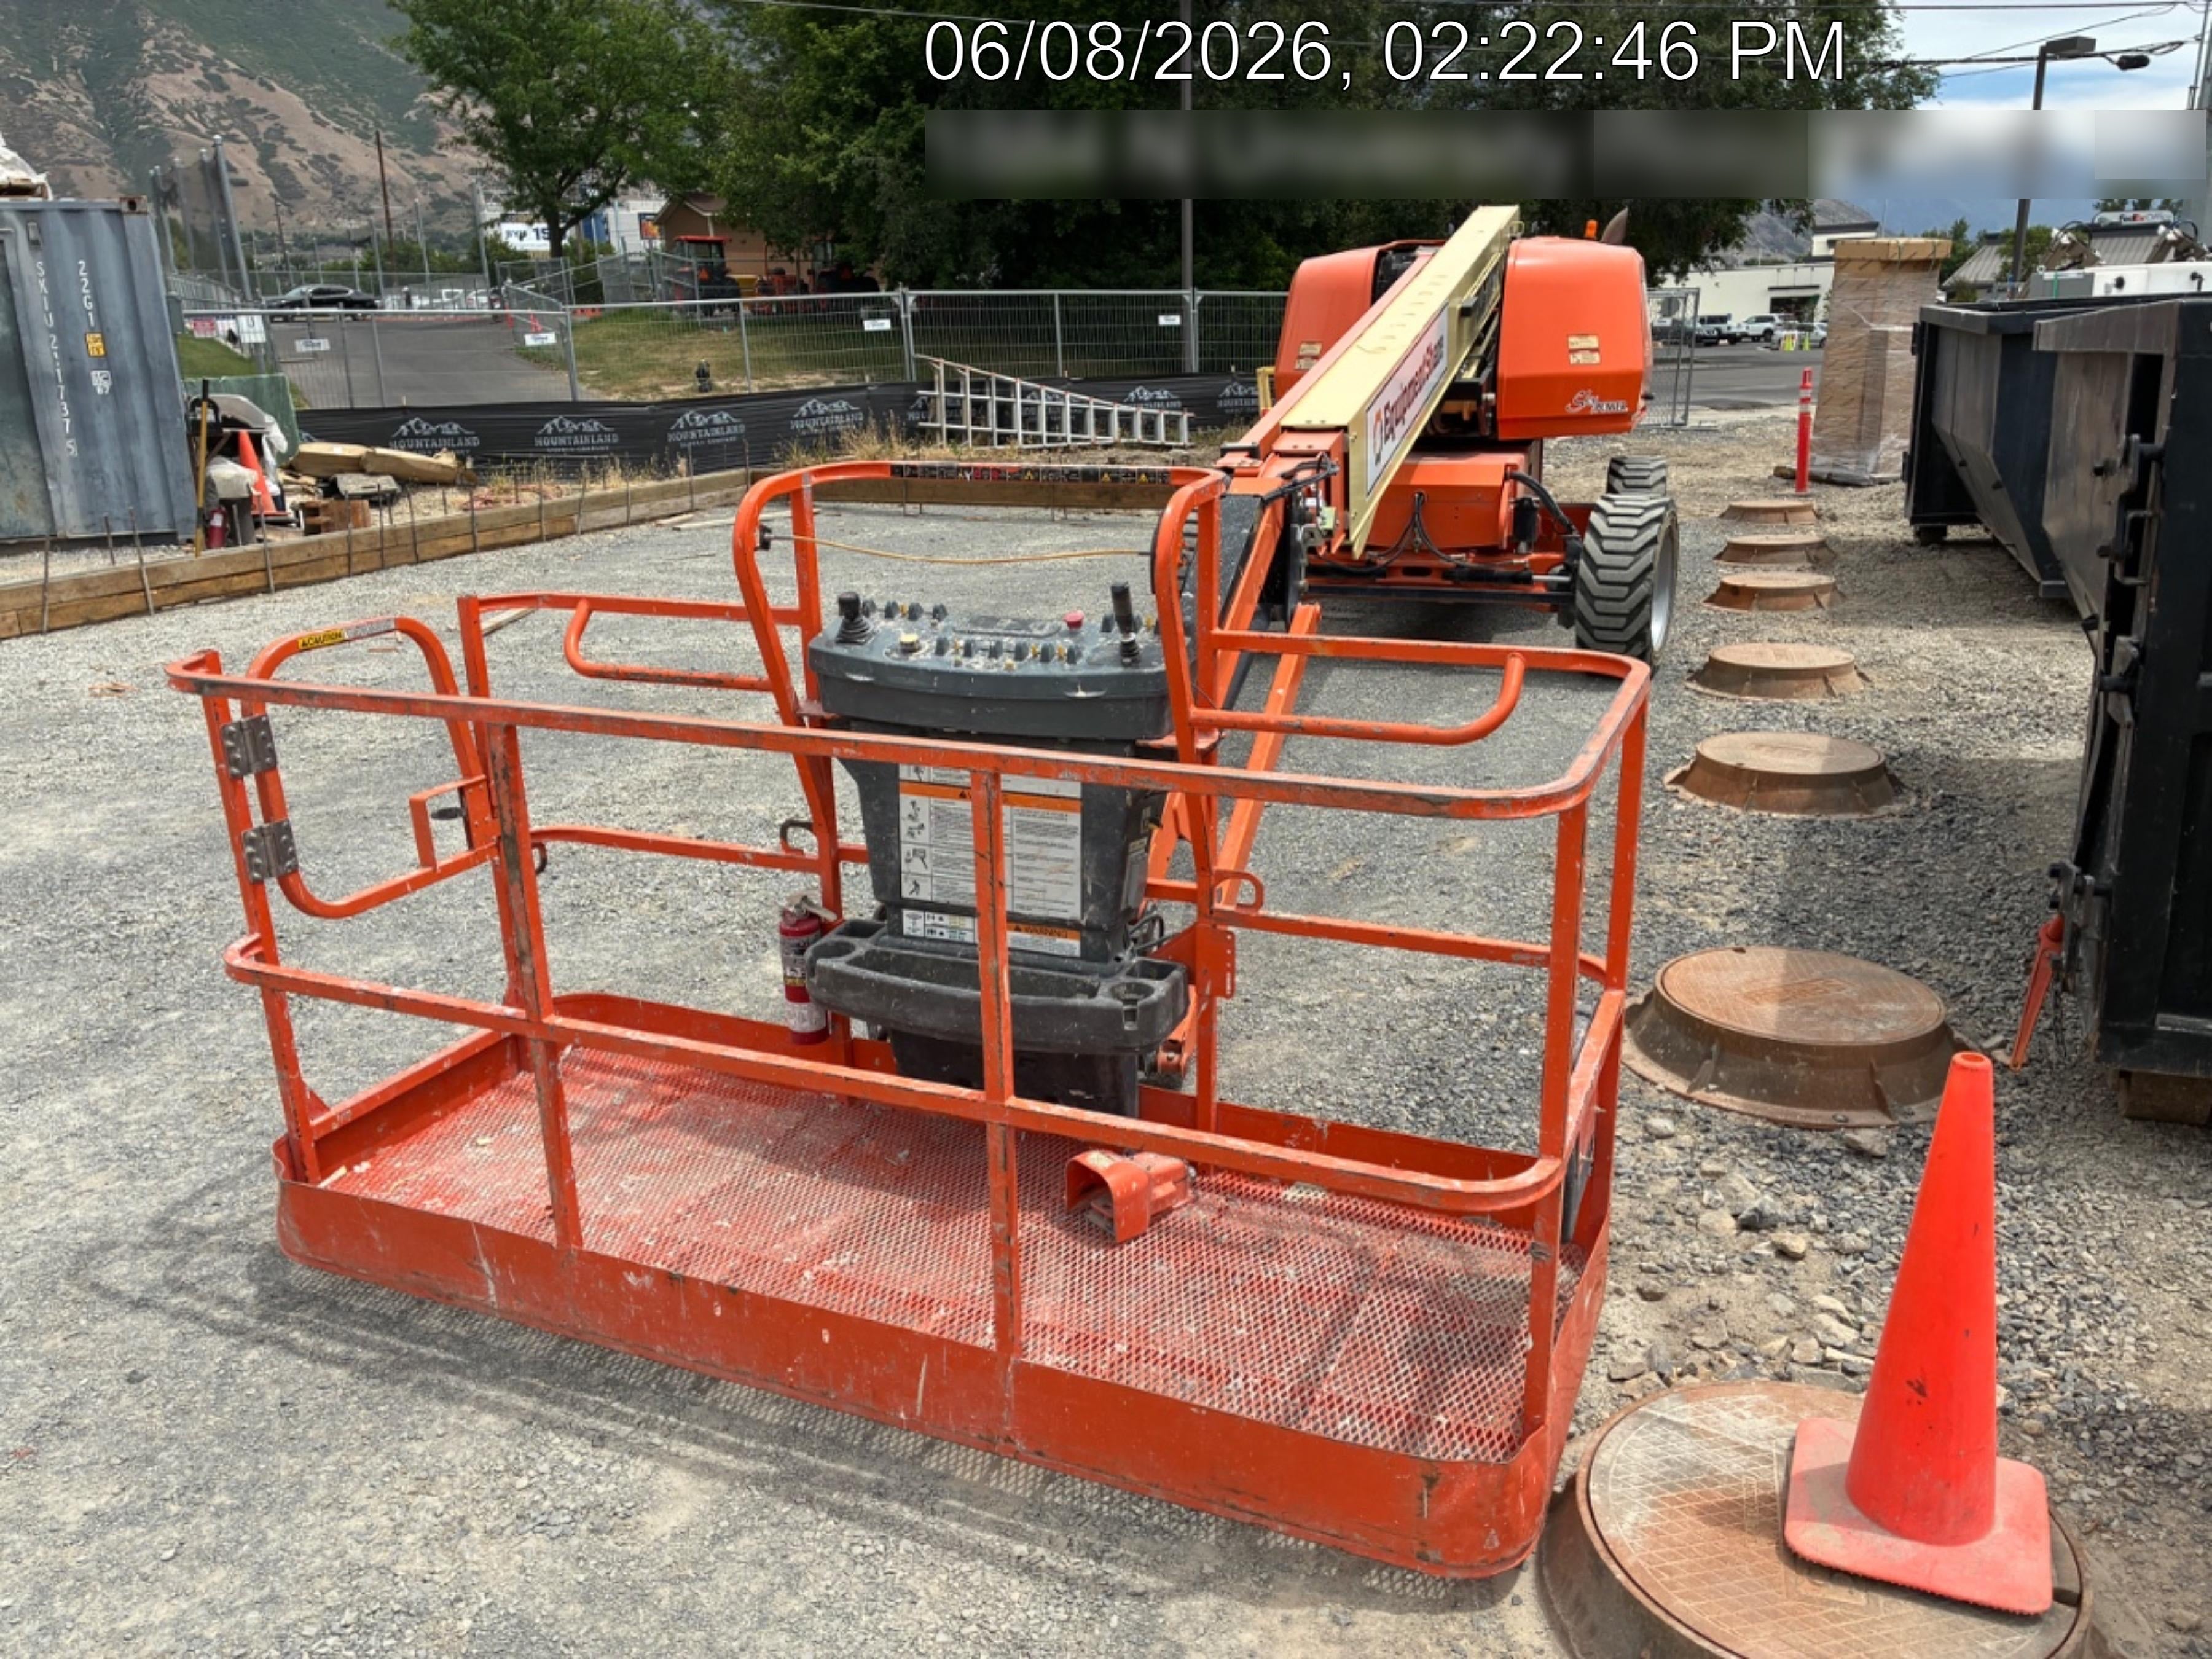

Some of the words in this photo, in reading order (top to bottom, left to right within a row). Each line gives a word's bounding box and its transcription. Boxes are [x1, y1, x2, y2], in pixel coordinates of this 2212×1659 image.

[77, 260, 95, 327] 22G1
[534, 433, 619, 447] MOUNTAINLAND
[308, 629, 342, 645] CAUTION
